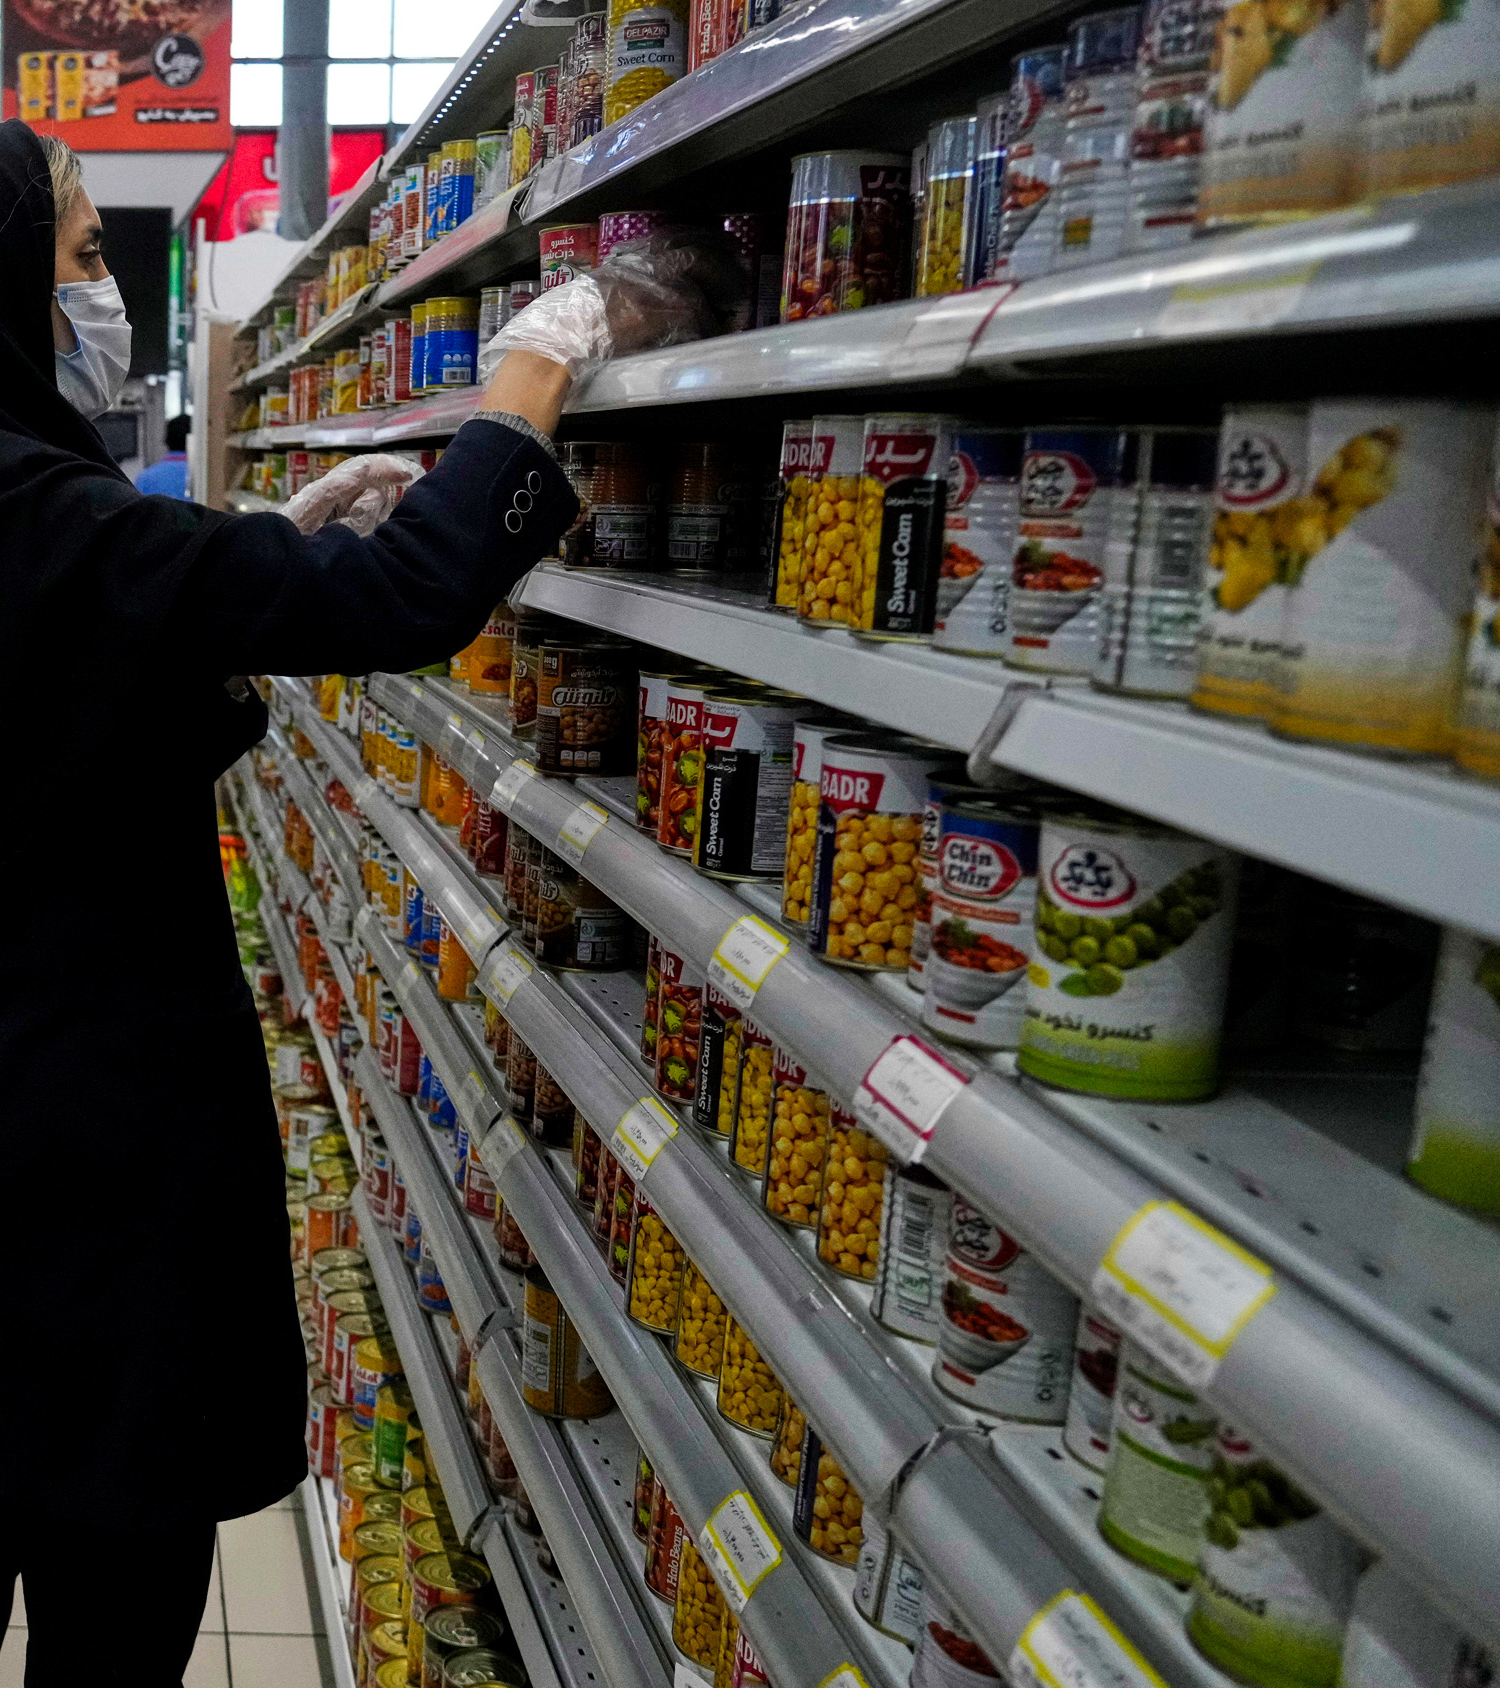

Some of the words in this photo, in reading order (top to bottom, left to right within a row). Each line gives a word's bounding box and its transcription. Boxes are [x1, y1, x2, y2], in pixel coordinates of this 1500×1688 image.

[626, 24, 669, 38] DELPAZIR
[617, 55, 645, 67] Sweet
[648, 52, 675, 63] Corn
[550, 235, 575, 248] کنسرو
[865, 439, 927, 476] بدر
[892, 512, 914, 557] Corn
[887, 556, 909, 613] Sweet
[667, 701, 698, 727] BADR
[702, 718, 732, 746] بد
[709, 776, 722, 811] Corn
[820, 769, 871, 804] BADR
[706, 811, 721, 855] Sweet
[948, 843, 993, 867] Chin
[946, 864, 991, 888] Chin
[661, 957, 675, 979] DR
[708, 987, 729, 1008] BA
[1045, 1012, 1083, 1031] نخود
[1086, 1024, 1155, 1040] کنسرو
[701, 1035, 711, 1068] Corn
[698, 1068, 709, 1111] Sweet
[669, 1525, 684, 1561] Beans
[666, 1559, 680, 1587] Halo
